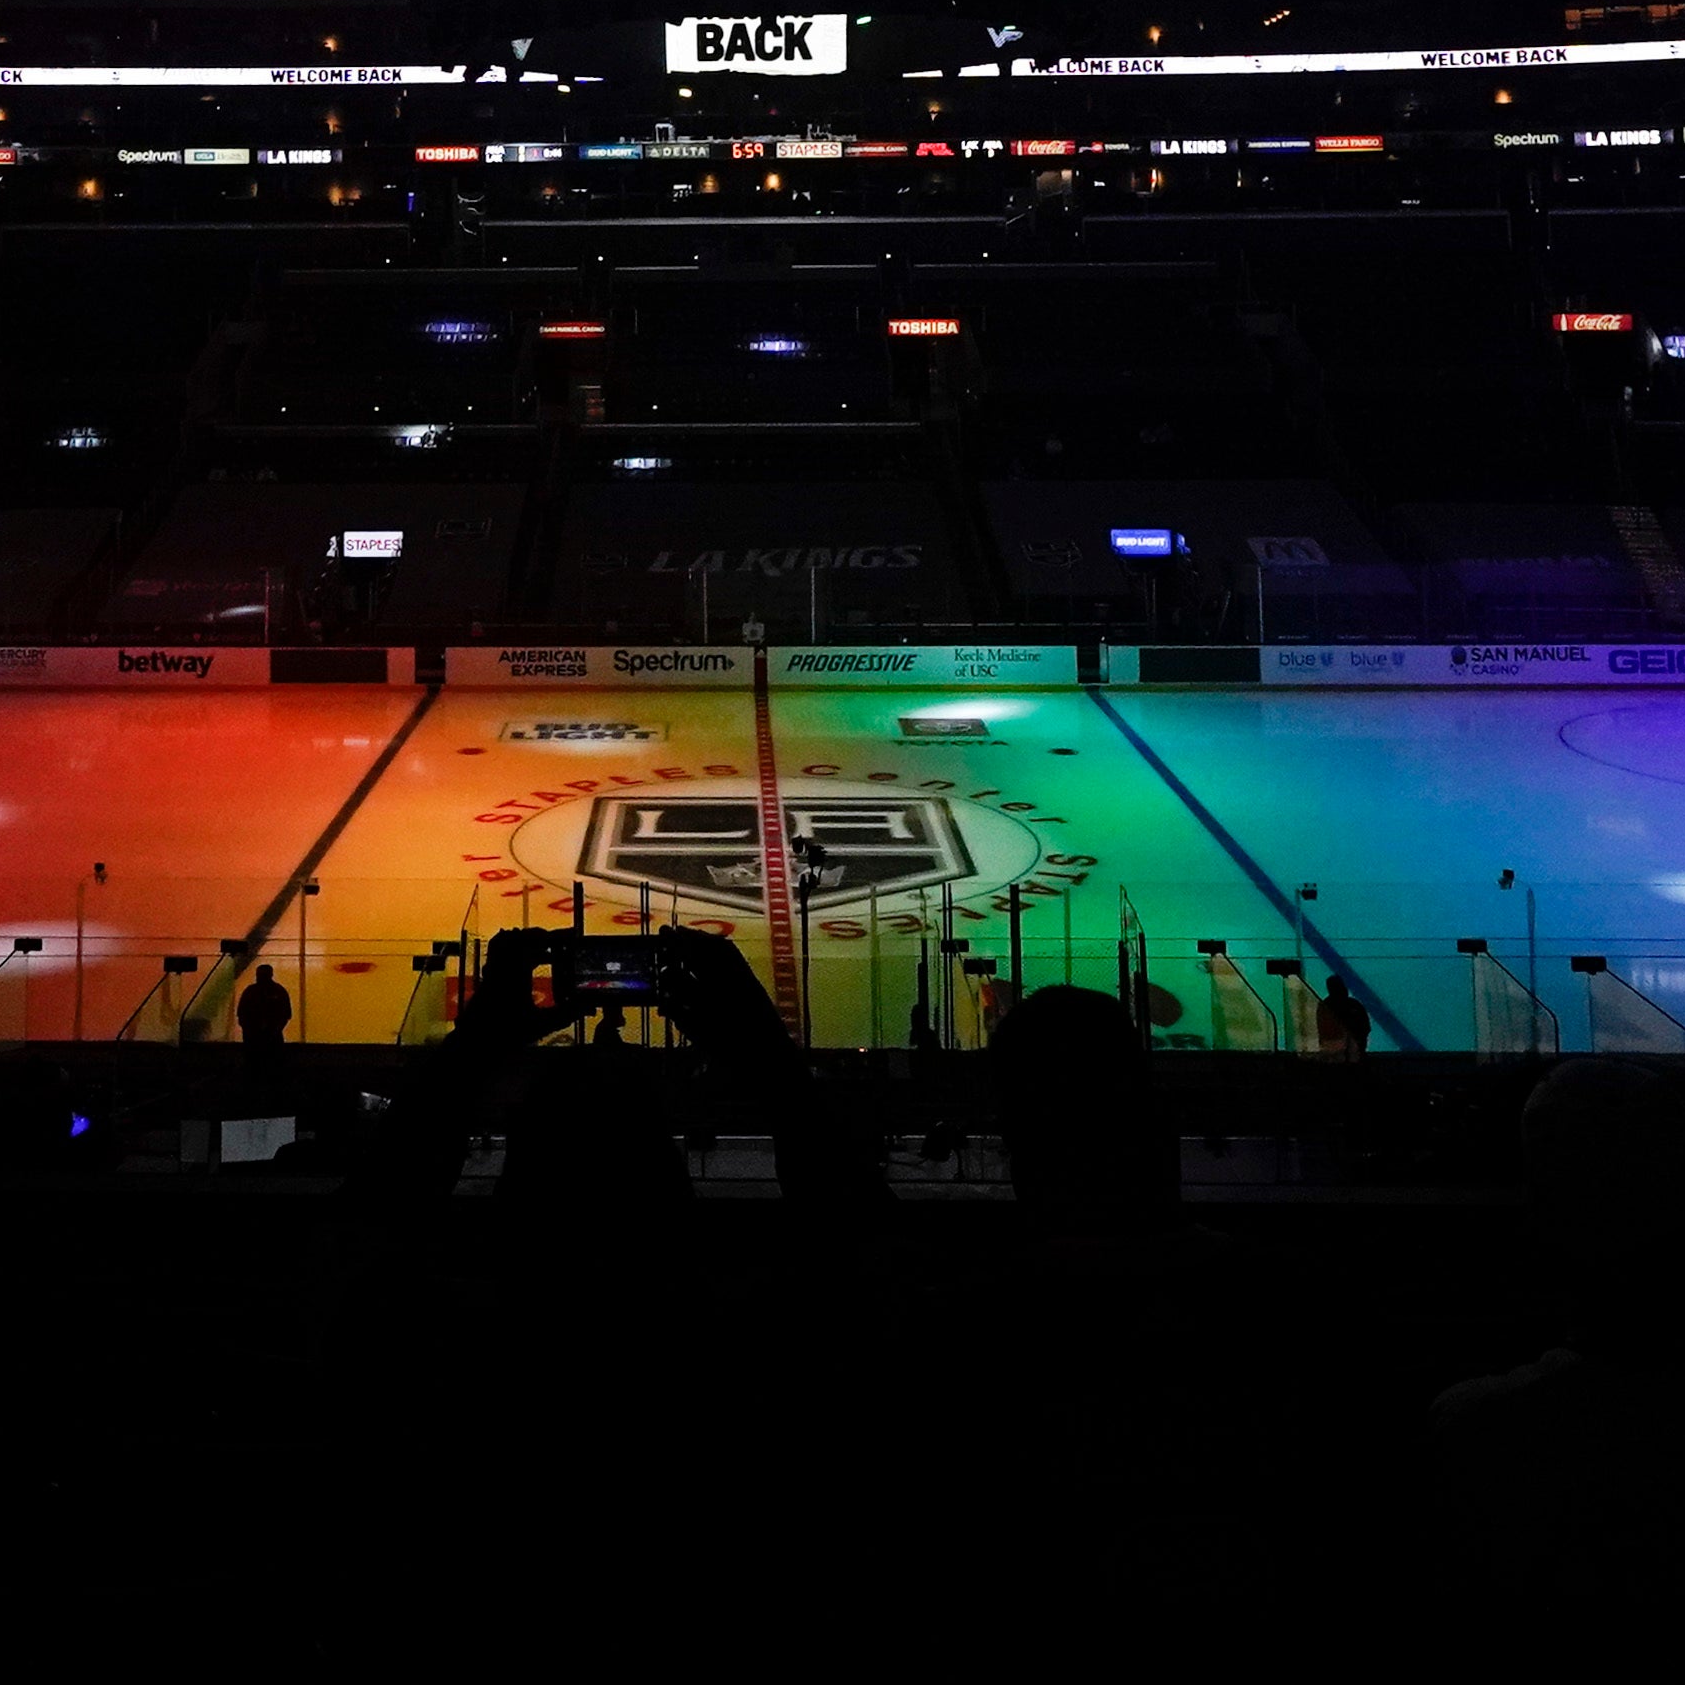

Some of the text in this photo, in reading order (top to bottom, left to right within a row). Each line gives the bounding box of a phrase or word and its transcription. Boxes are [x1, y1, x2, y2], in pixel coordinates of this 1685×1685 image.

[694, 22, 813, 62] BACK
[1421, 48, 1568, 66] WELCOME BACK
[1029, 59, 1165, 74] WELCOME BACK
[271, 68, 402, 83] WELCOME BACK
[1318, 138, 1380, 147] WELLS FARGO
[1493, 133, 1559, 149] Spectrum
[1585, 130, 1661, 146] LA KINGS
[416, 147, 478, 160] TOSHIBA
[662, 147, 707, 157] DELTA
[732, 143, 764, 159] 6:59
[778, 143, 840, 156] STAPLES
[1160, 140, 1227, 155] LA KINGS
[117, 149, 177, 164] Spectrum
[266, 150, 332, 165] LA KINGS
[889, 321, 959, 335] TOSHIBA
[1573, 313, 1623, 331] Coca-Cola
[346, 539, 400, 551] STAPLES
[1116, 536, 1165, 546] BUD LIGHT
[499, 650, 586, 663] AMERICAN
[954, 648, 1041, 662] Keck Medicine
[1279, 652, 1316, 666] blue
[1350, 652, 1387, 666] blue
[1471, 647, 1591, 662] SAN MANUEL
[118, 650, 214, 679] betway
[613, 649, 727, 676] Spectrum
[787, 654, 918, 672] PROGRESSIVE
[954, 663, 999, 677] of USC
[1471, 664, 1519, 676] CASINO
[511, 664, 588, 677] EXPRESS
